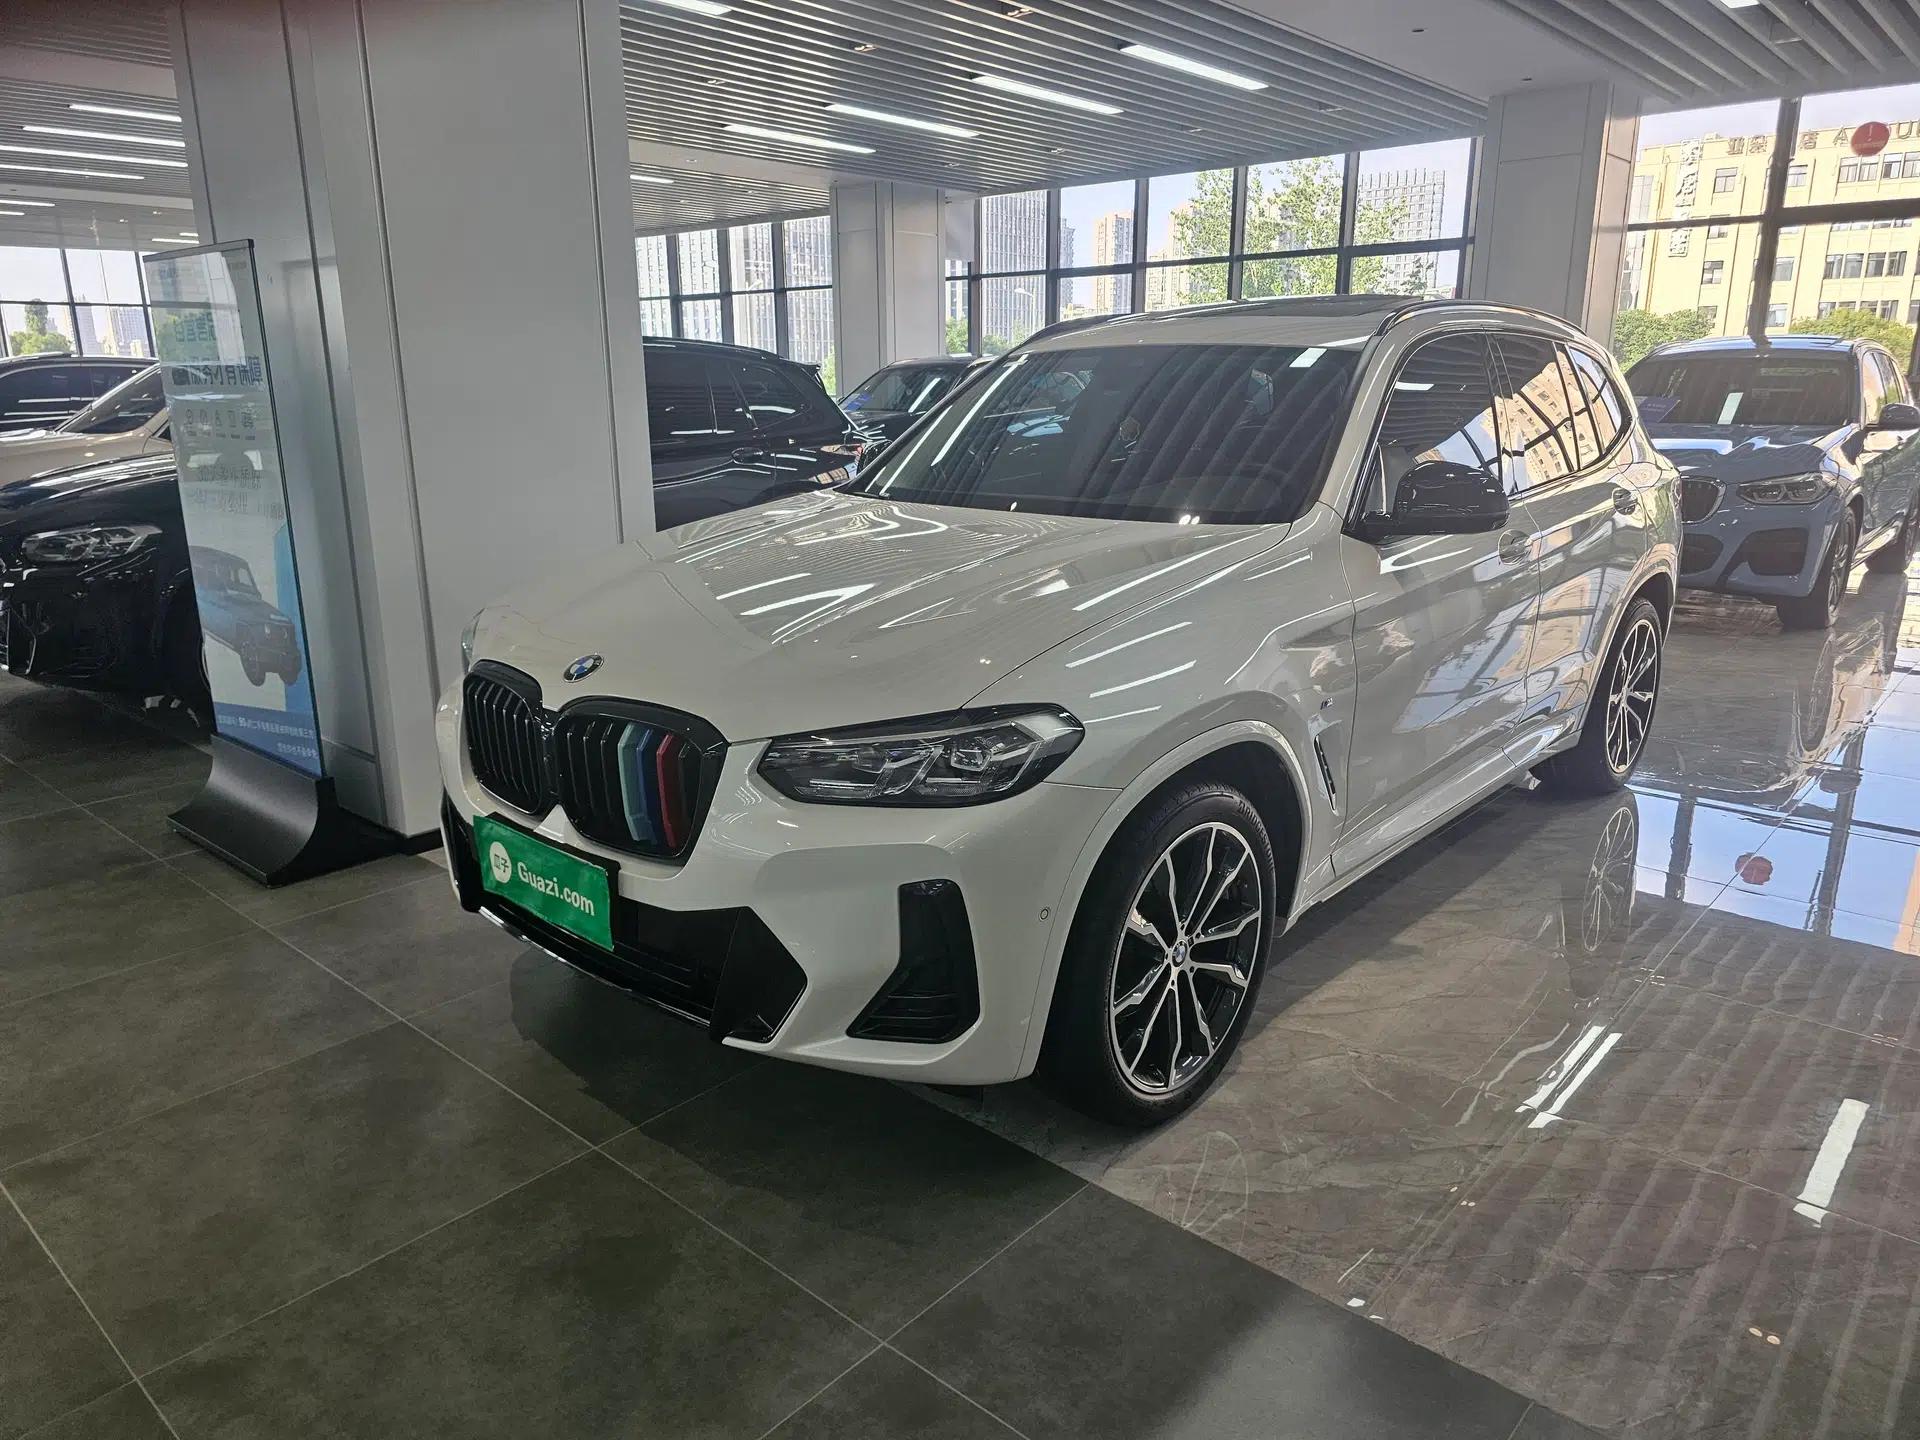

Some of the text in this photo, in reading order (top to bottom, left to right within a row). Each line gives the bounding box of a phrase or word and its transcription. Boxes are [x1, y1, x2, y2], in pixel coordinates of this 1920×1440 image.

[1726, 131, 1819, 156] 亚朵店
[517, 861, 595, 916] Guazi.com
